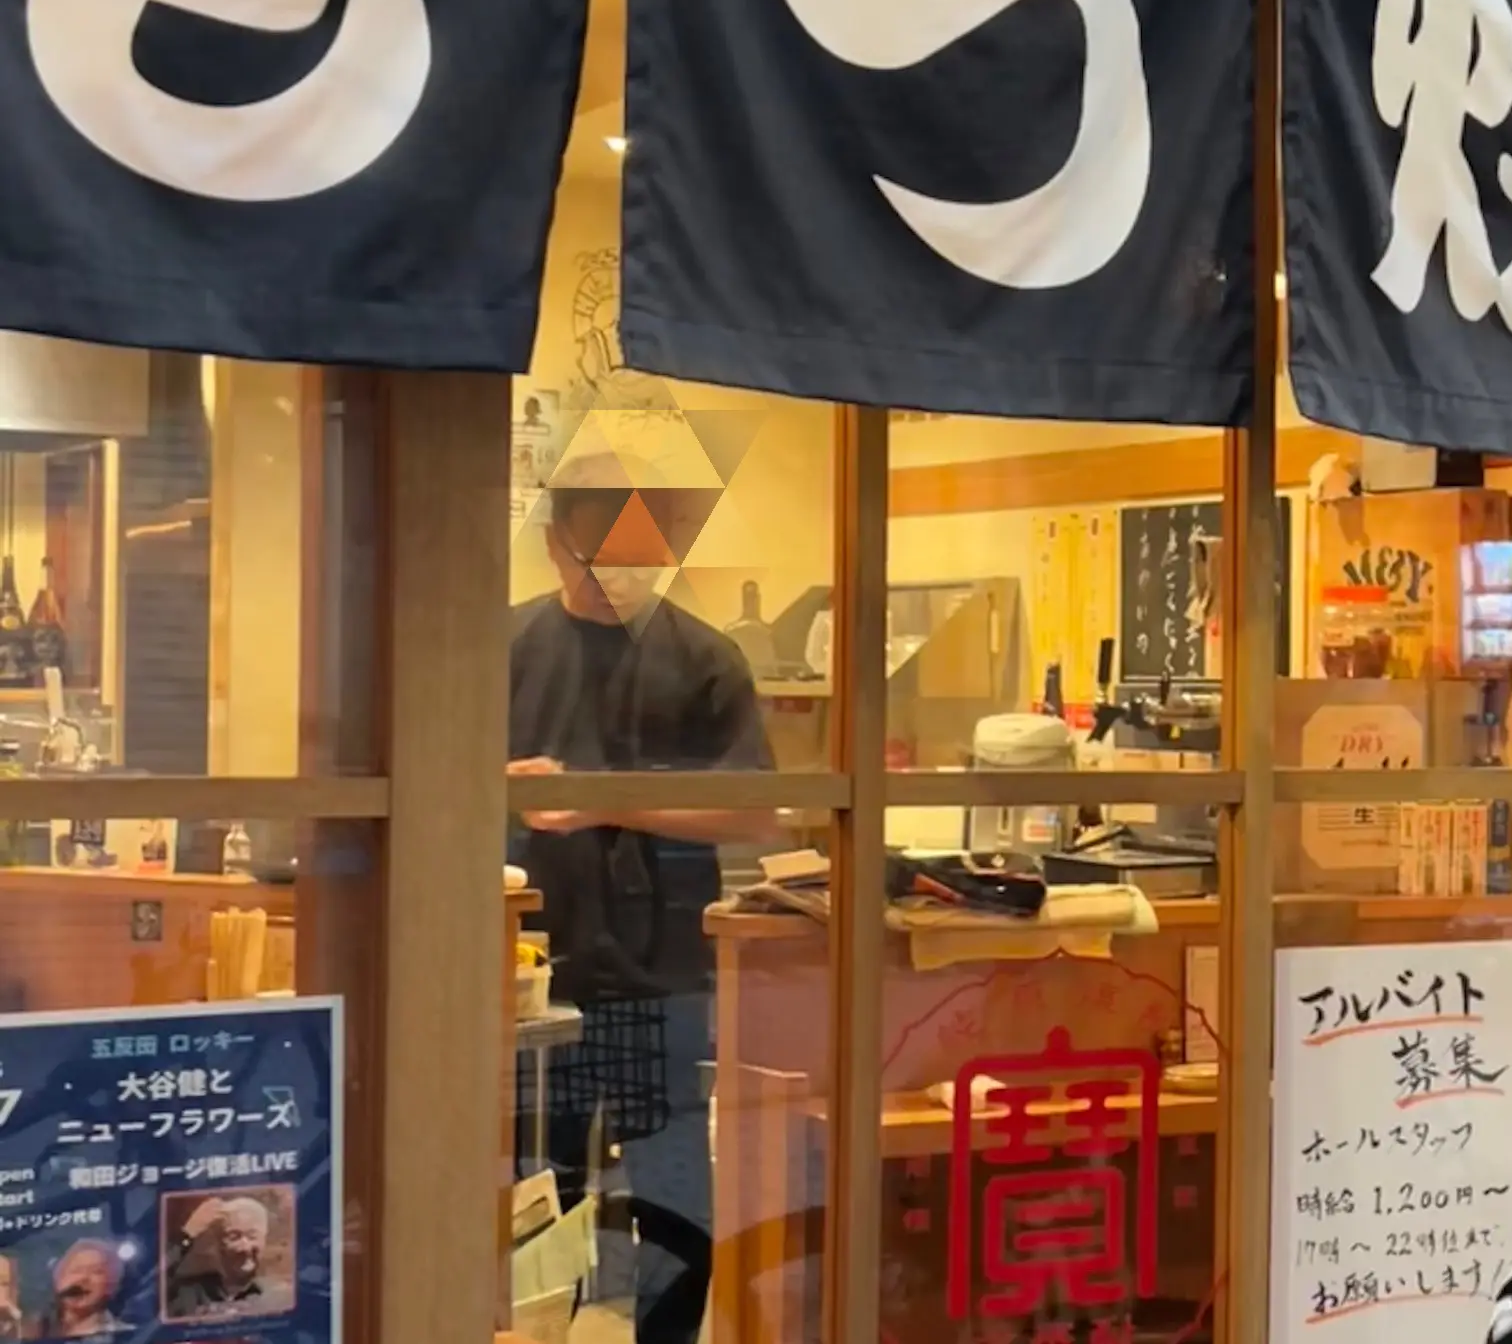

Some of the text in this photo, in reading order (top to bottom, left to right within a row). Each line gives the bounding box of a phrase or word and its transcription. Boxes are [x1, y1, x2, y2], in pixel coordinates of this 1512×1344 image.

[1353, 807, 1374, 824] 生
[1299, 970, 1484, 1034] アルバイト
[170, 1030, 254, 1053] ロッキー
[1392, 1031, 1509, 1097] 募集
[117, 1069, 233, 1101] 大谷健と
[57, 1101, 294, 1143] ニューフラワーズ
[1302, 1121, 1473, 1162] ホールスタッフ
